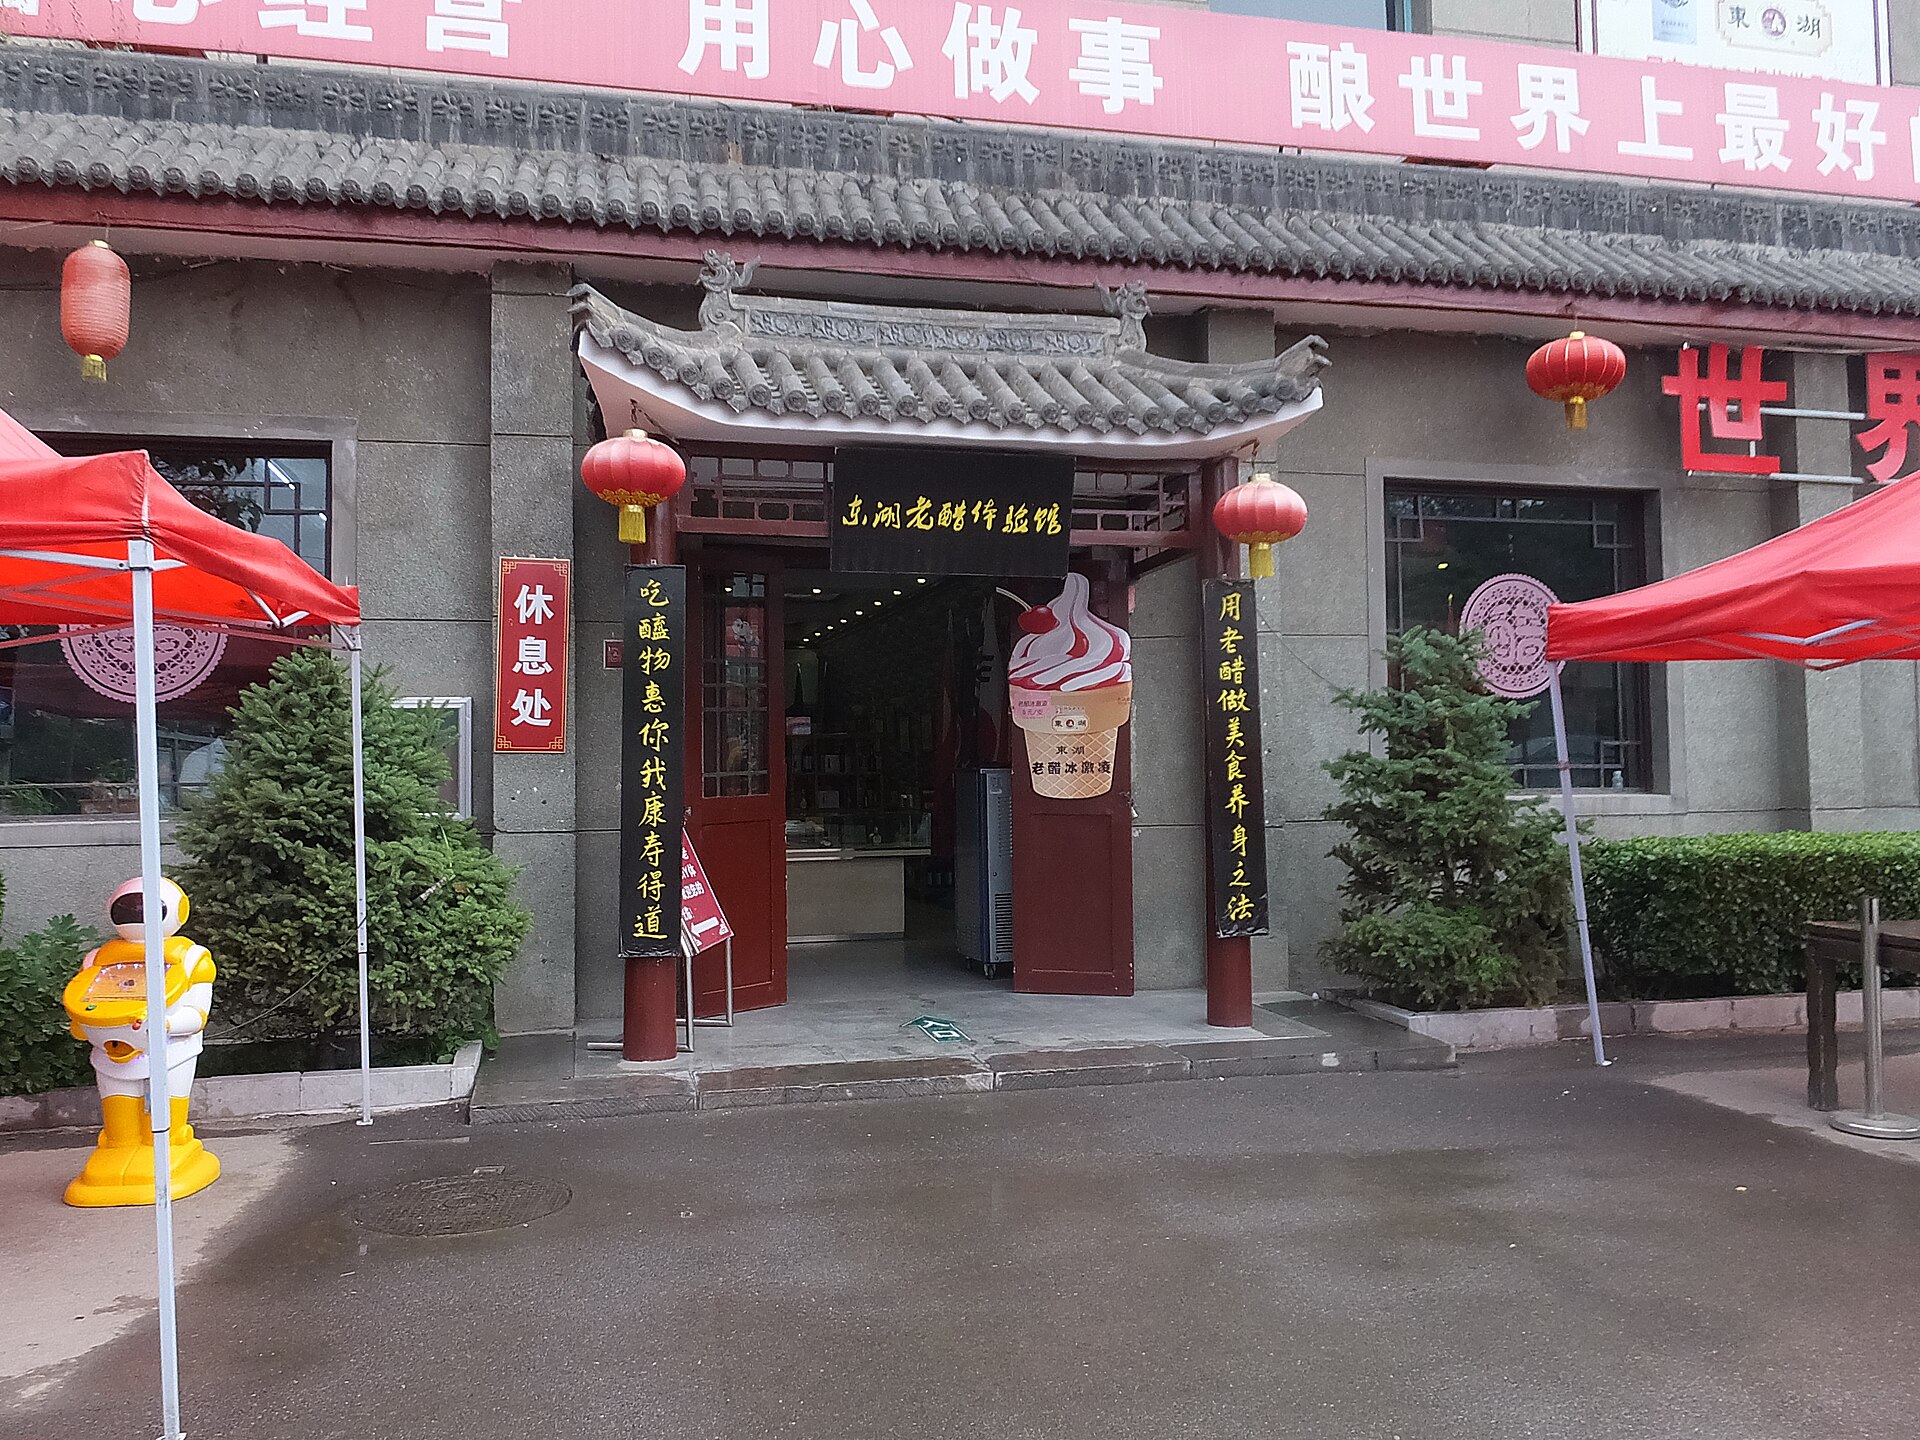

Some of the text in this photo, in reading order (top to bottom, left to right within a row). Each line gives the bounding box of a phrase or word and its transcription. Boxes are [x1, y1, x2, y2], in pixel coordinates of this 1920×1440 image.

[1285, 40, 1920, 183] 酿世界上最好
[842, 494, 1063, 535] 东湖老醋体验馆
[511, 584, 555, 727] 休息处
[1056, 745, 1085, 755] 東湖
[1217, 591, 1256, 921] 用老醋做美食养身之法
